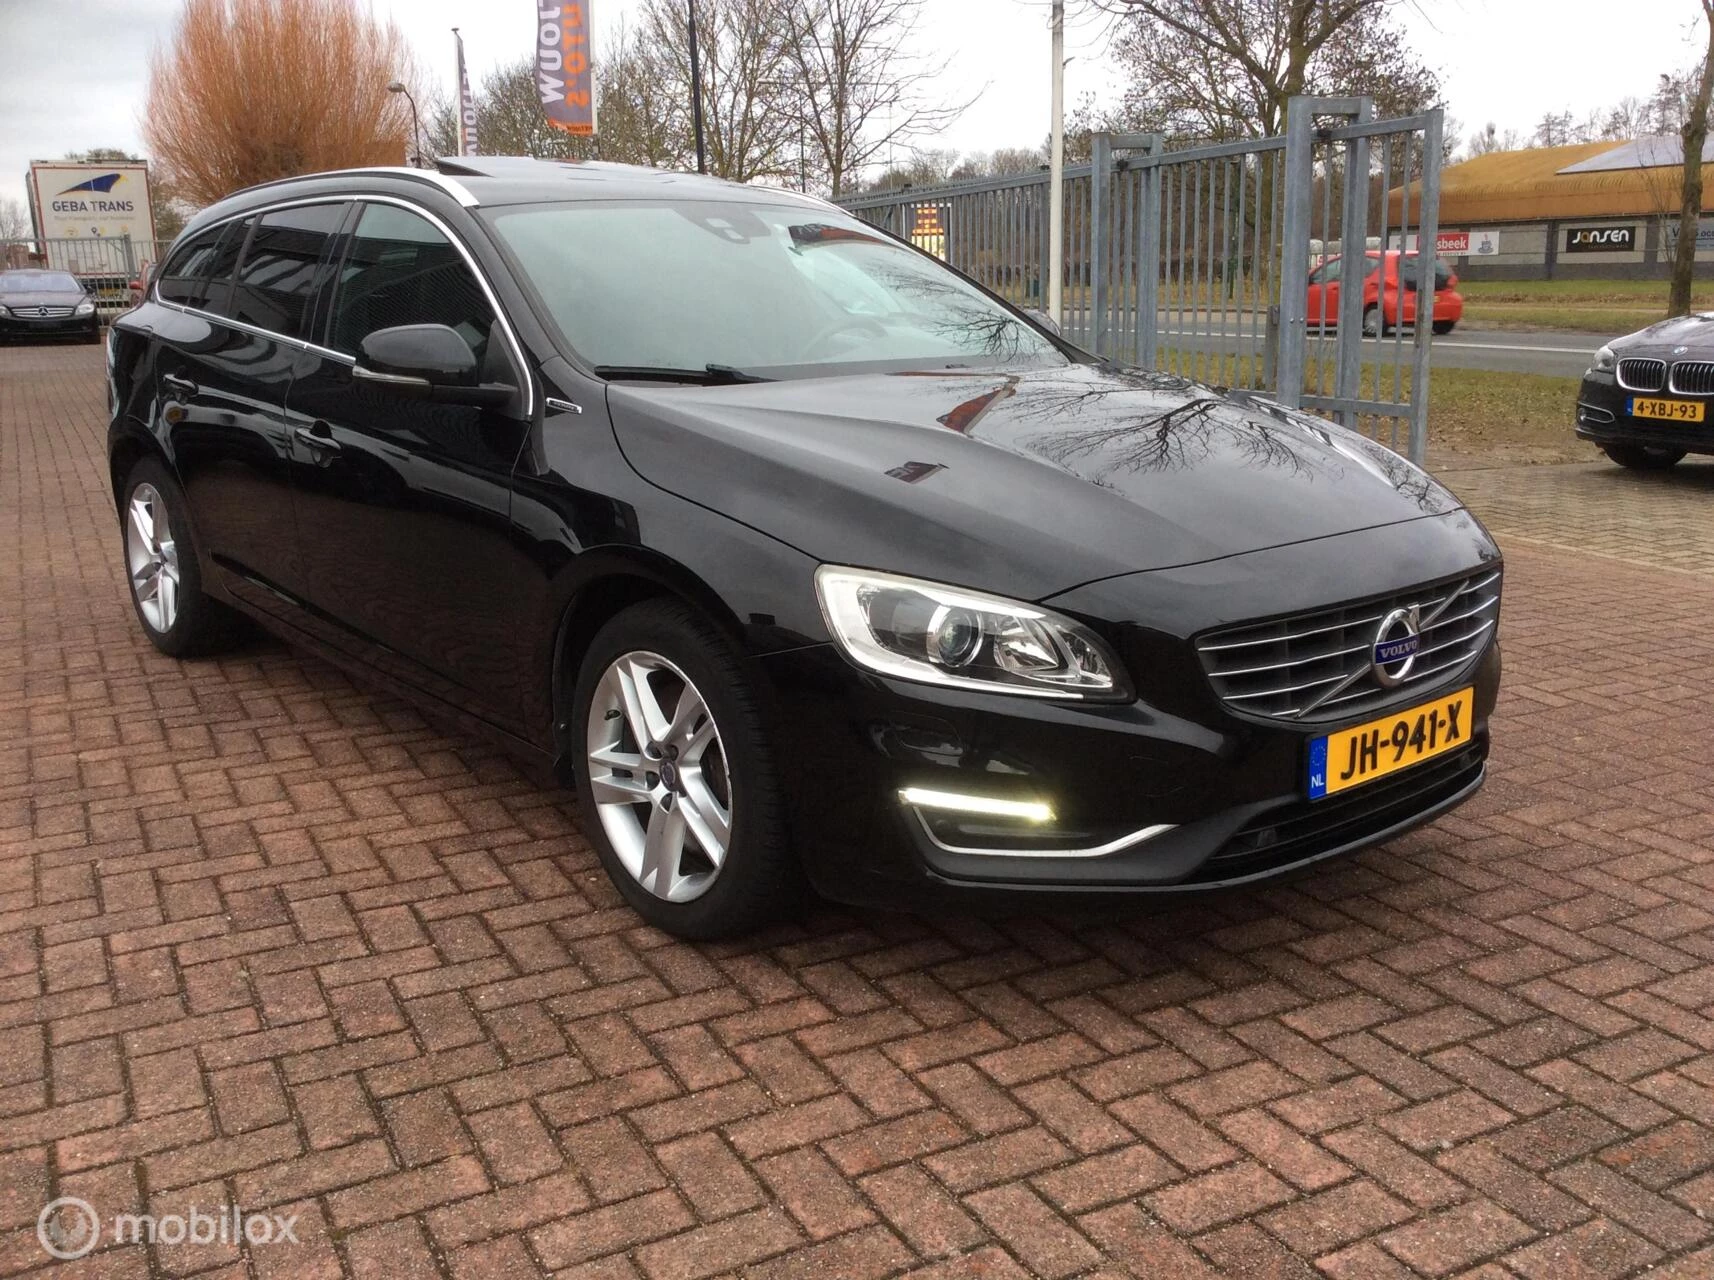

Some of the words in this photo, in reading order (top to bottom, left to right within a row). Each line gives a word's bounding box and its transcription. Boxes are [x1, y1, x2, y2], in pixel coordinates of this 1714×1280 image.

[52, 200, 88, 212] GEBA
[90, 200, 134, 212] TRANS
[1436, 236, 1467, 250] sbeek
[1637, 401, 1697, 419] 4-XBJ-93
[1380, 639, 1418, 659] VOLVO
[1340, 699, 1463, 781] JH-941-X
[1311, 773, 1325, 788] NL
